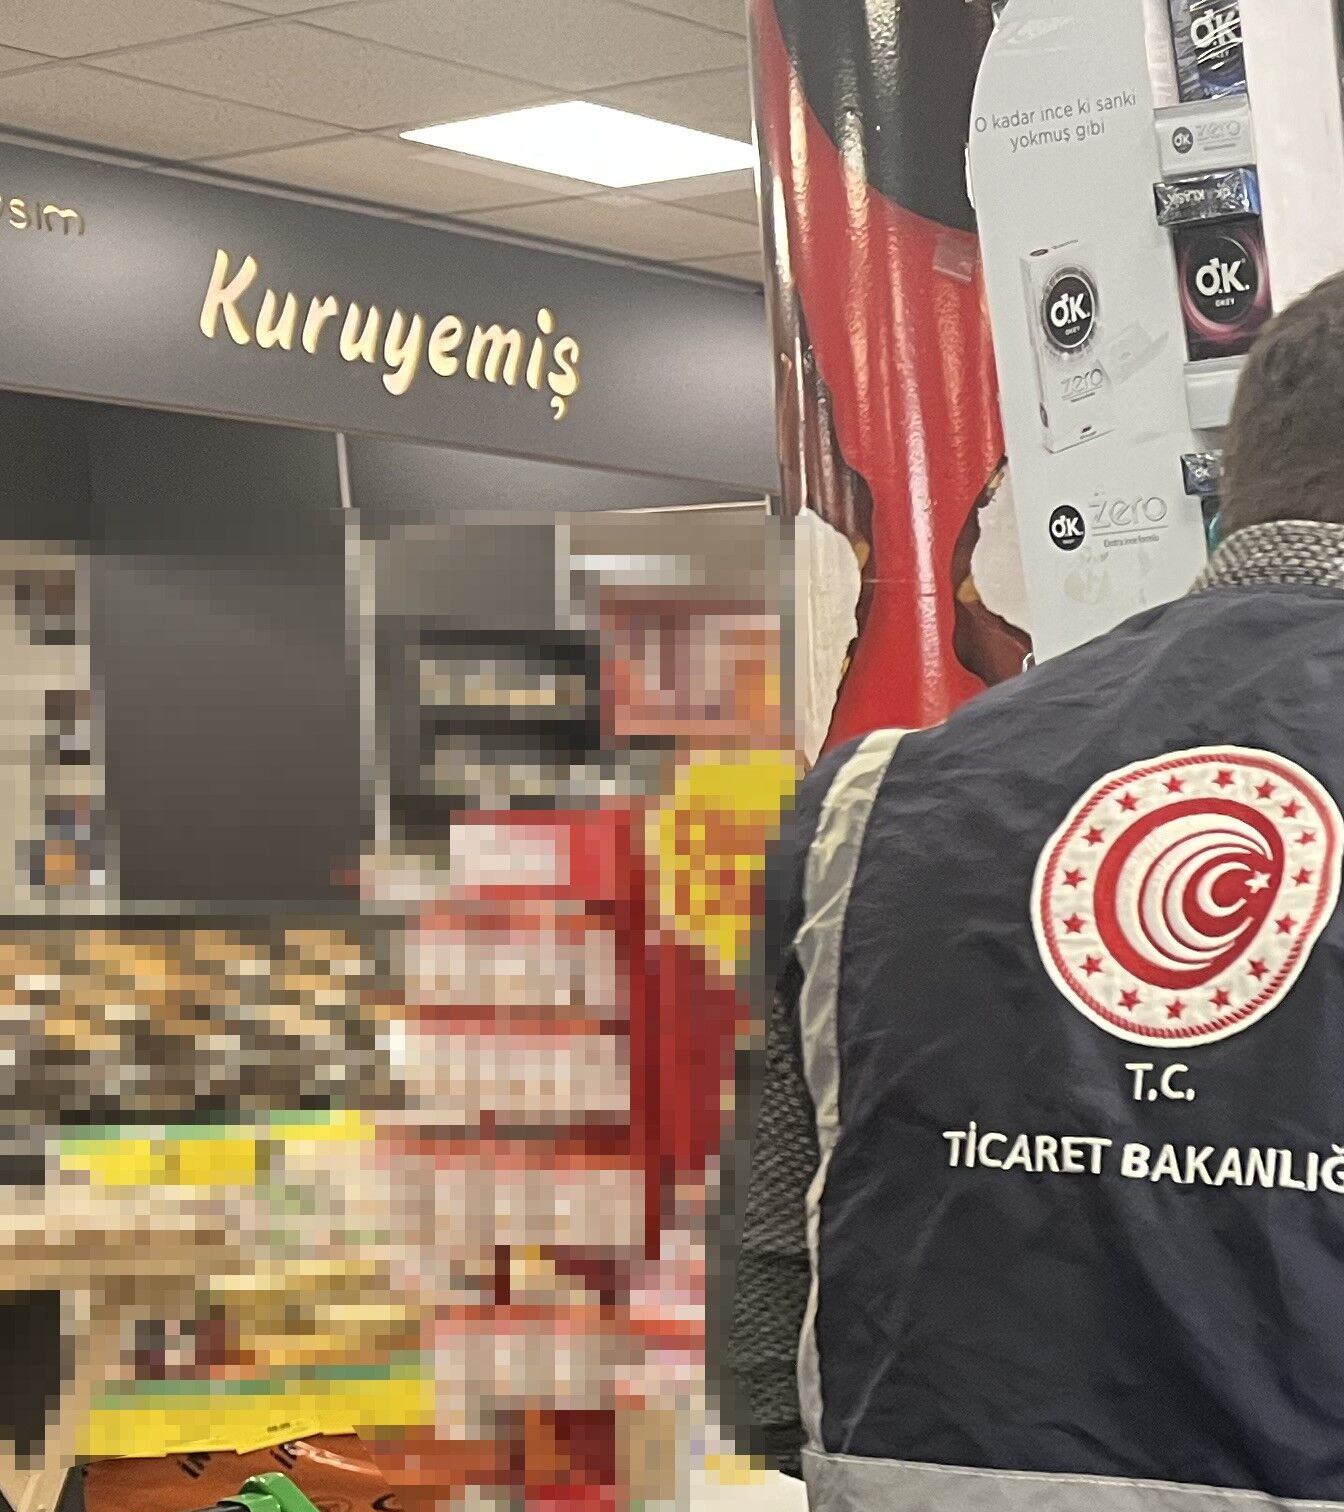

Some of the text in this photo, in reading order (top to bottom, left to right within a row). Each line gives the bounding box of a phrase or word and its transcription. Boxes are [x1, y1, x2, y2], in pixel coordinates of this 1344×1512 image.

[974, 91, 1137, 133] O kadar ince ki sanki
[1009, 119, 1106, 153] yokmuş gibi
[200, 248, 582, 421] Kuruyemiş
[1125, 1062, 1197, 1102] T.C.
[942, 1121, 1113, 1175] TİCARET
